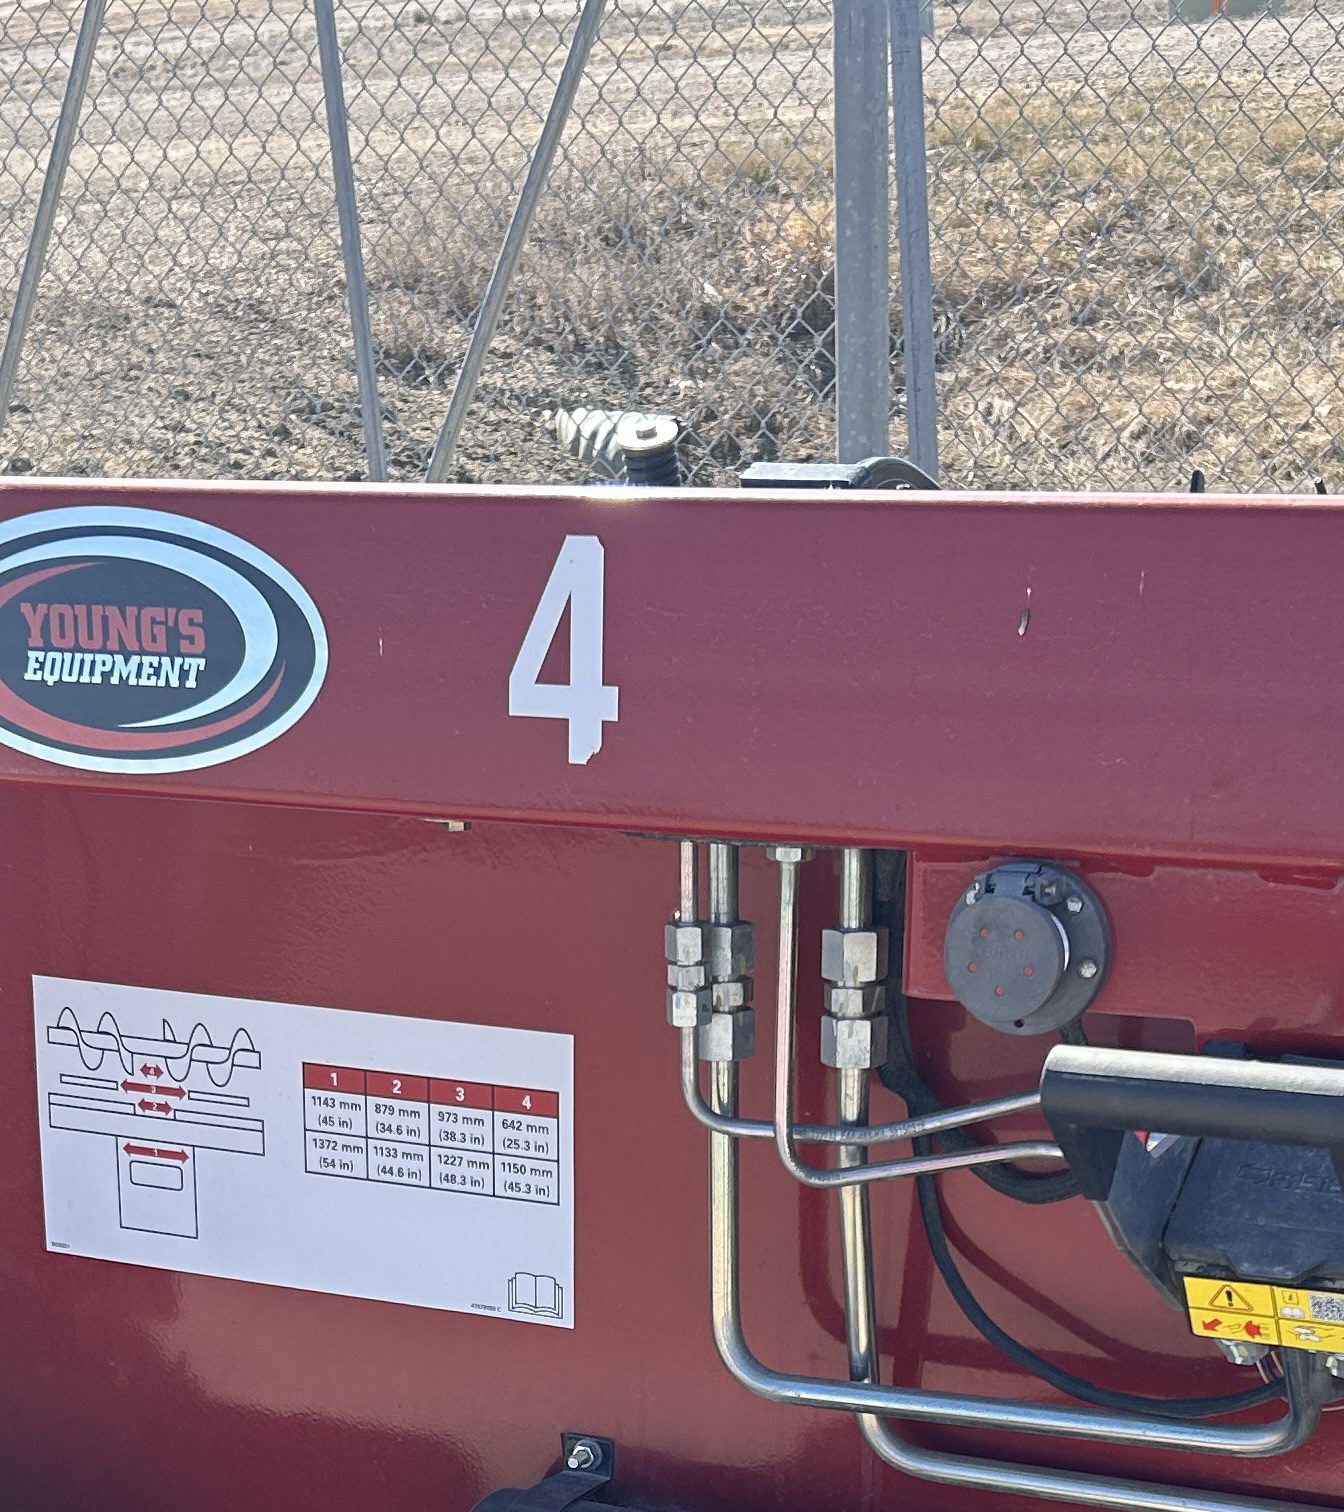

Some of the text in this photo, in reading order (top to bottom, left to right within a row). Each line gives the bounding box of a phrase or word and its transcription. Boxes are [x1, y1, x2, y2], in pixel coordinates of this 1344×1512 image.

[20, 602, 206, 654] YOUNG'S
[508, 534, 619, 766] 4
[23, 650, 206, 689] EQUIPMENT
[330, 1072, 338, 1086] 1
[392, 1079, 402, 1094] 2
[455, 1086, 465, 1102] 3
[521, 1094, 532, 1110] 4
[311, 1095, 362, 1112] 1143 mm
[374, 1102, 421, 1119] 879 mm
[318, 1113, 353, 1131] (45 in)
[437, 1110, 485, 1127] 973 mm
[501, 1118, 550, 1136] 642 mm
[375, 1120, 421, 1139] (34.6 in)
[438, 1128, 485, 1148] (38.3 in)
[312, 1137, 364, 1155] 1372 mm
[372, 1145, 424, 1162] 1133 mm
[502, 1136, 549, 1155] (25.3 in)
[319, 1155, 354, 1173] (54 in)
[437, 1153, 490, 1170] 1227 mm
[500, 1161, 553, 1179] 1150 mm
[376, 1163, 422, 1181] (44.6 in)
[439, 1171, 485, 1190] (48.3 in)
[503, 1179, 550, 1198] (45.3 in)
